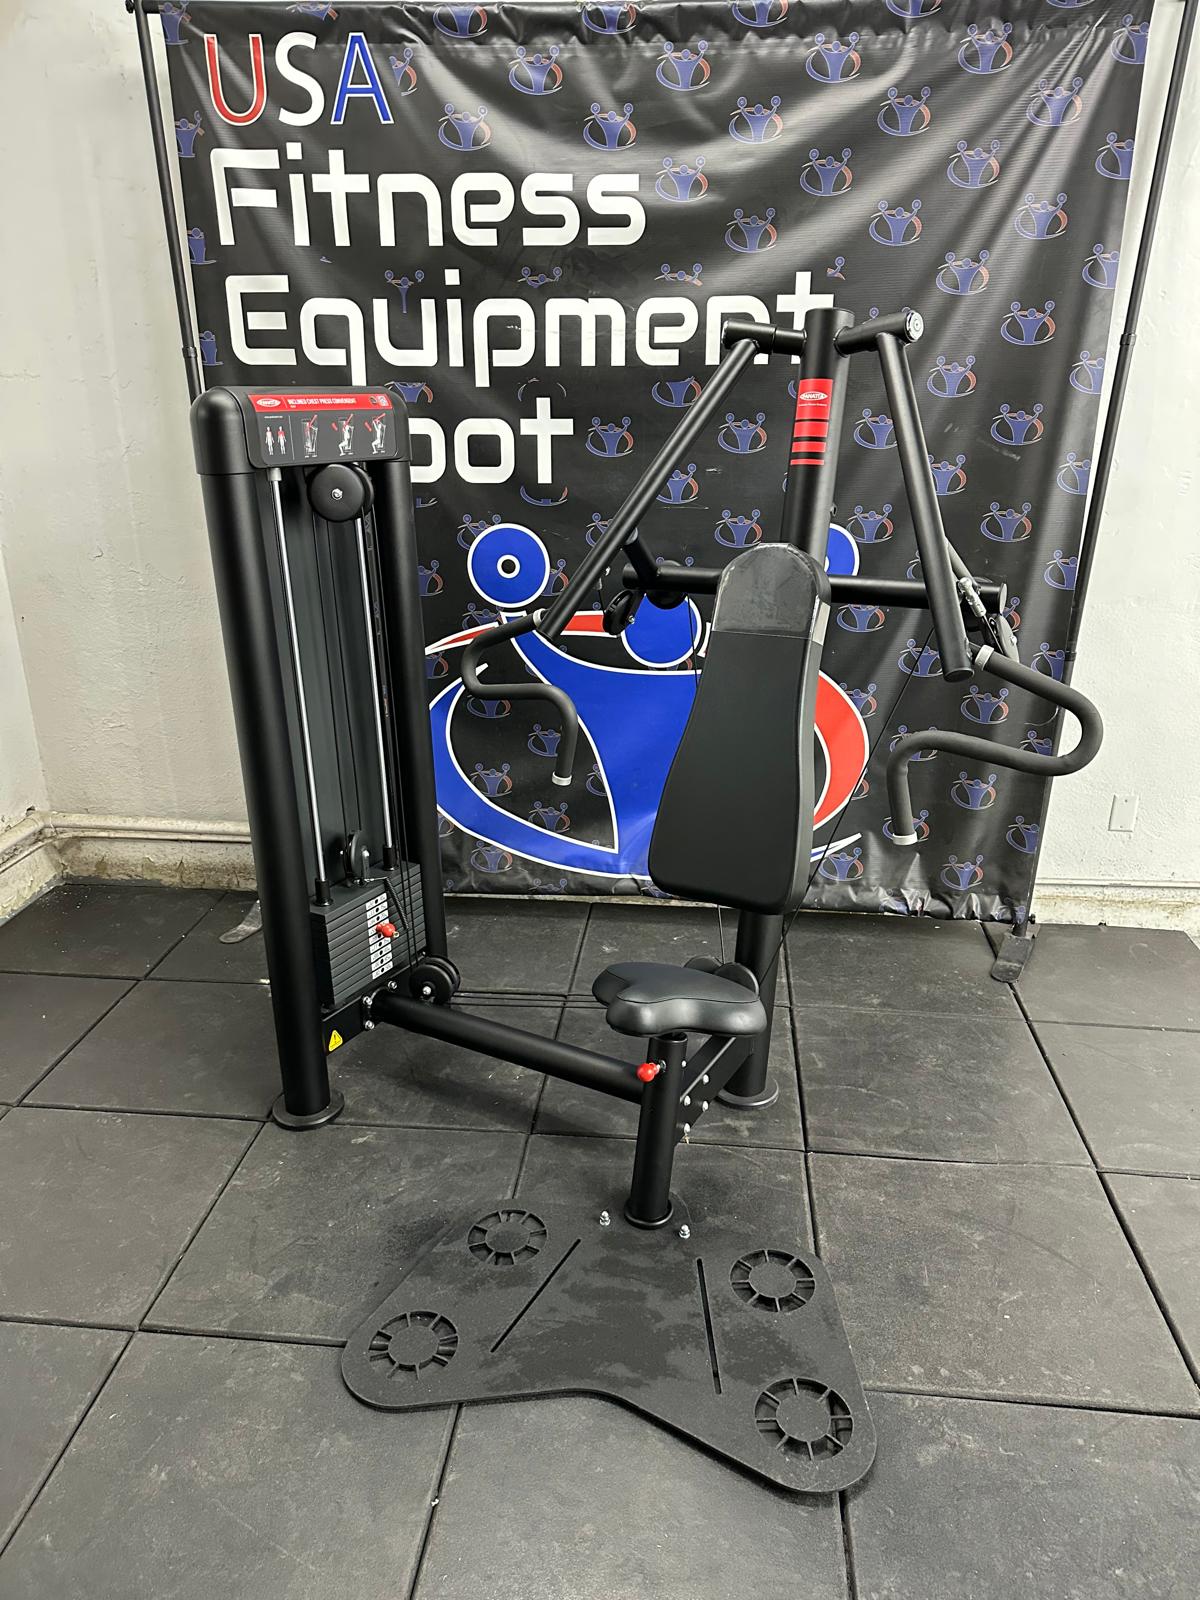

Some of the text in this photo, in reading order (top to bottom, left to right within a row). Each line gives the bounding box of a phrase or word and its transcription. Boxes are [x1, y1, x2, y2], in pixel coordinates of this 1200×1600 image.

[203, 32, 394, 126] USA
[211, 143, 646, 247] Fitness
[226, 269, 834, 388] Equipment
[409, 397, 574, 483] pot
